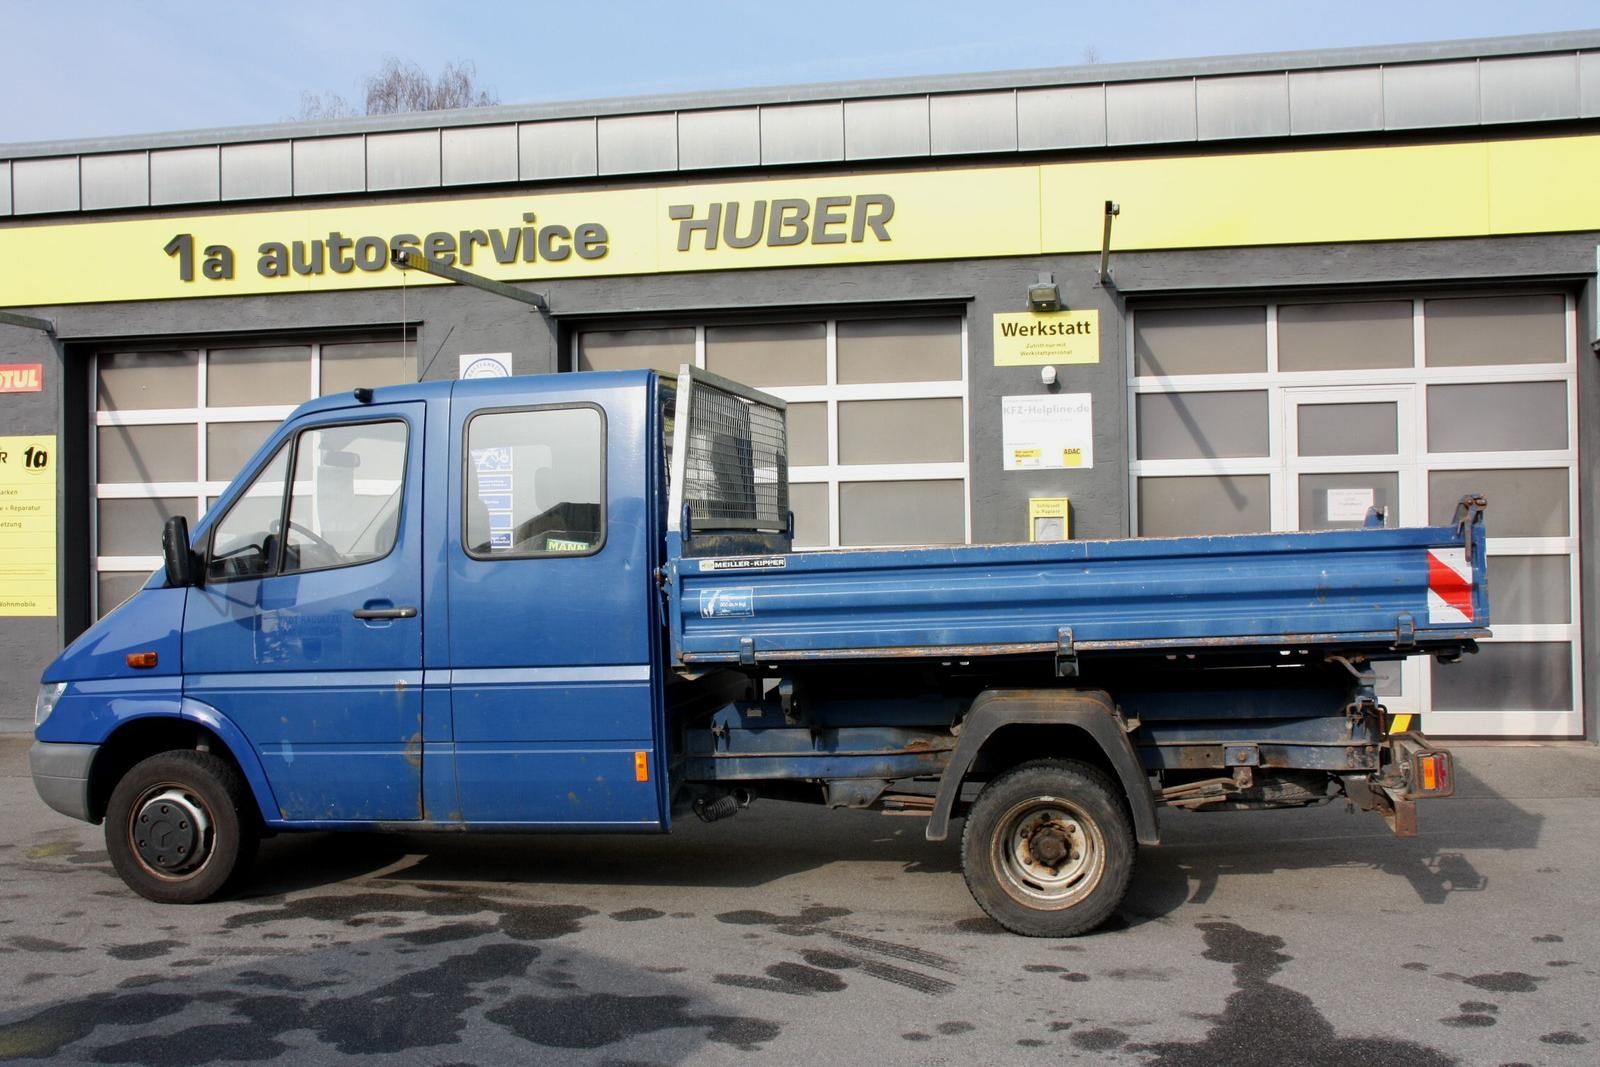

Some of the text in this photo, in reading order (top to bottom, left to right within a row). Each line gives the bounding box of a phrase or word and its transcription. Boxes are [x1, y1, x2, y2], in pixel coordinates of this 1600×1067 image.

[669, 193, 895, 252] HUBER
[163, 212, 609, 282] 1a autoservice
[1001, 321, 1091, 337] Werkstatt
[1003, 403, 1089, 416] KFZ-Helpline.de
[714, 560, 785, 569] MEILLER-KIPPER
